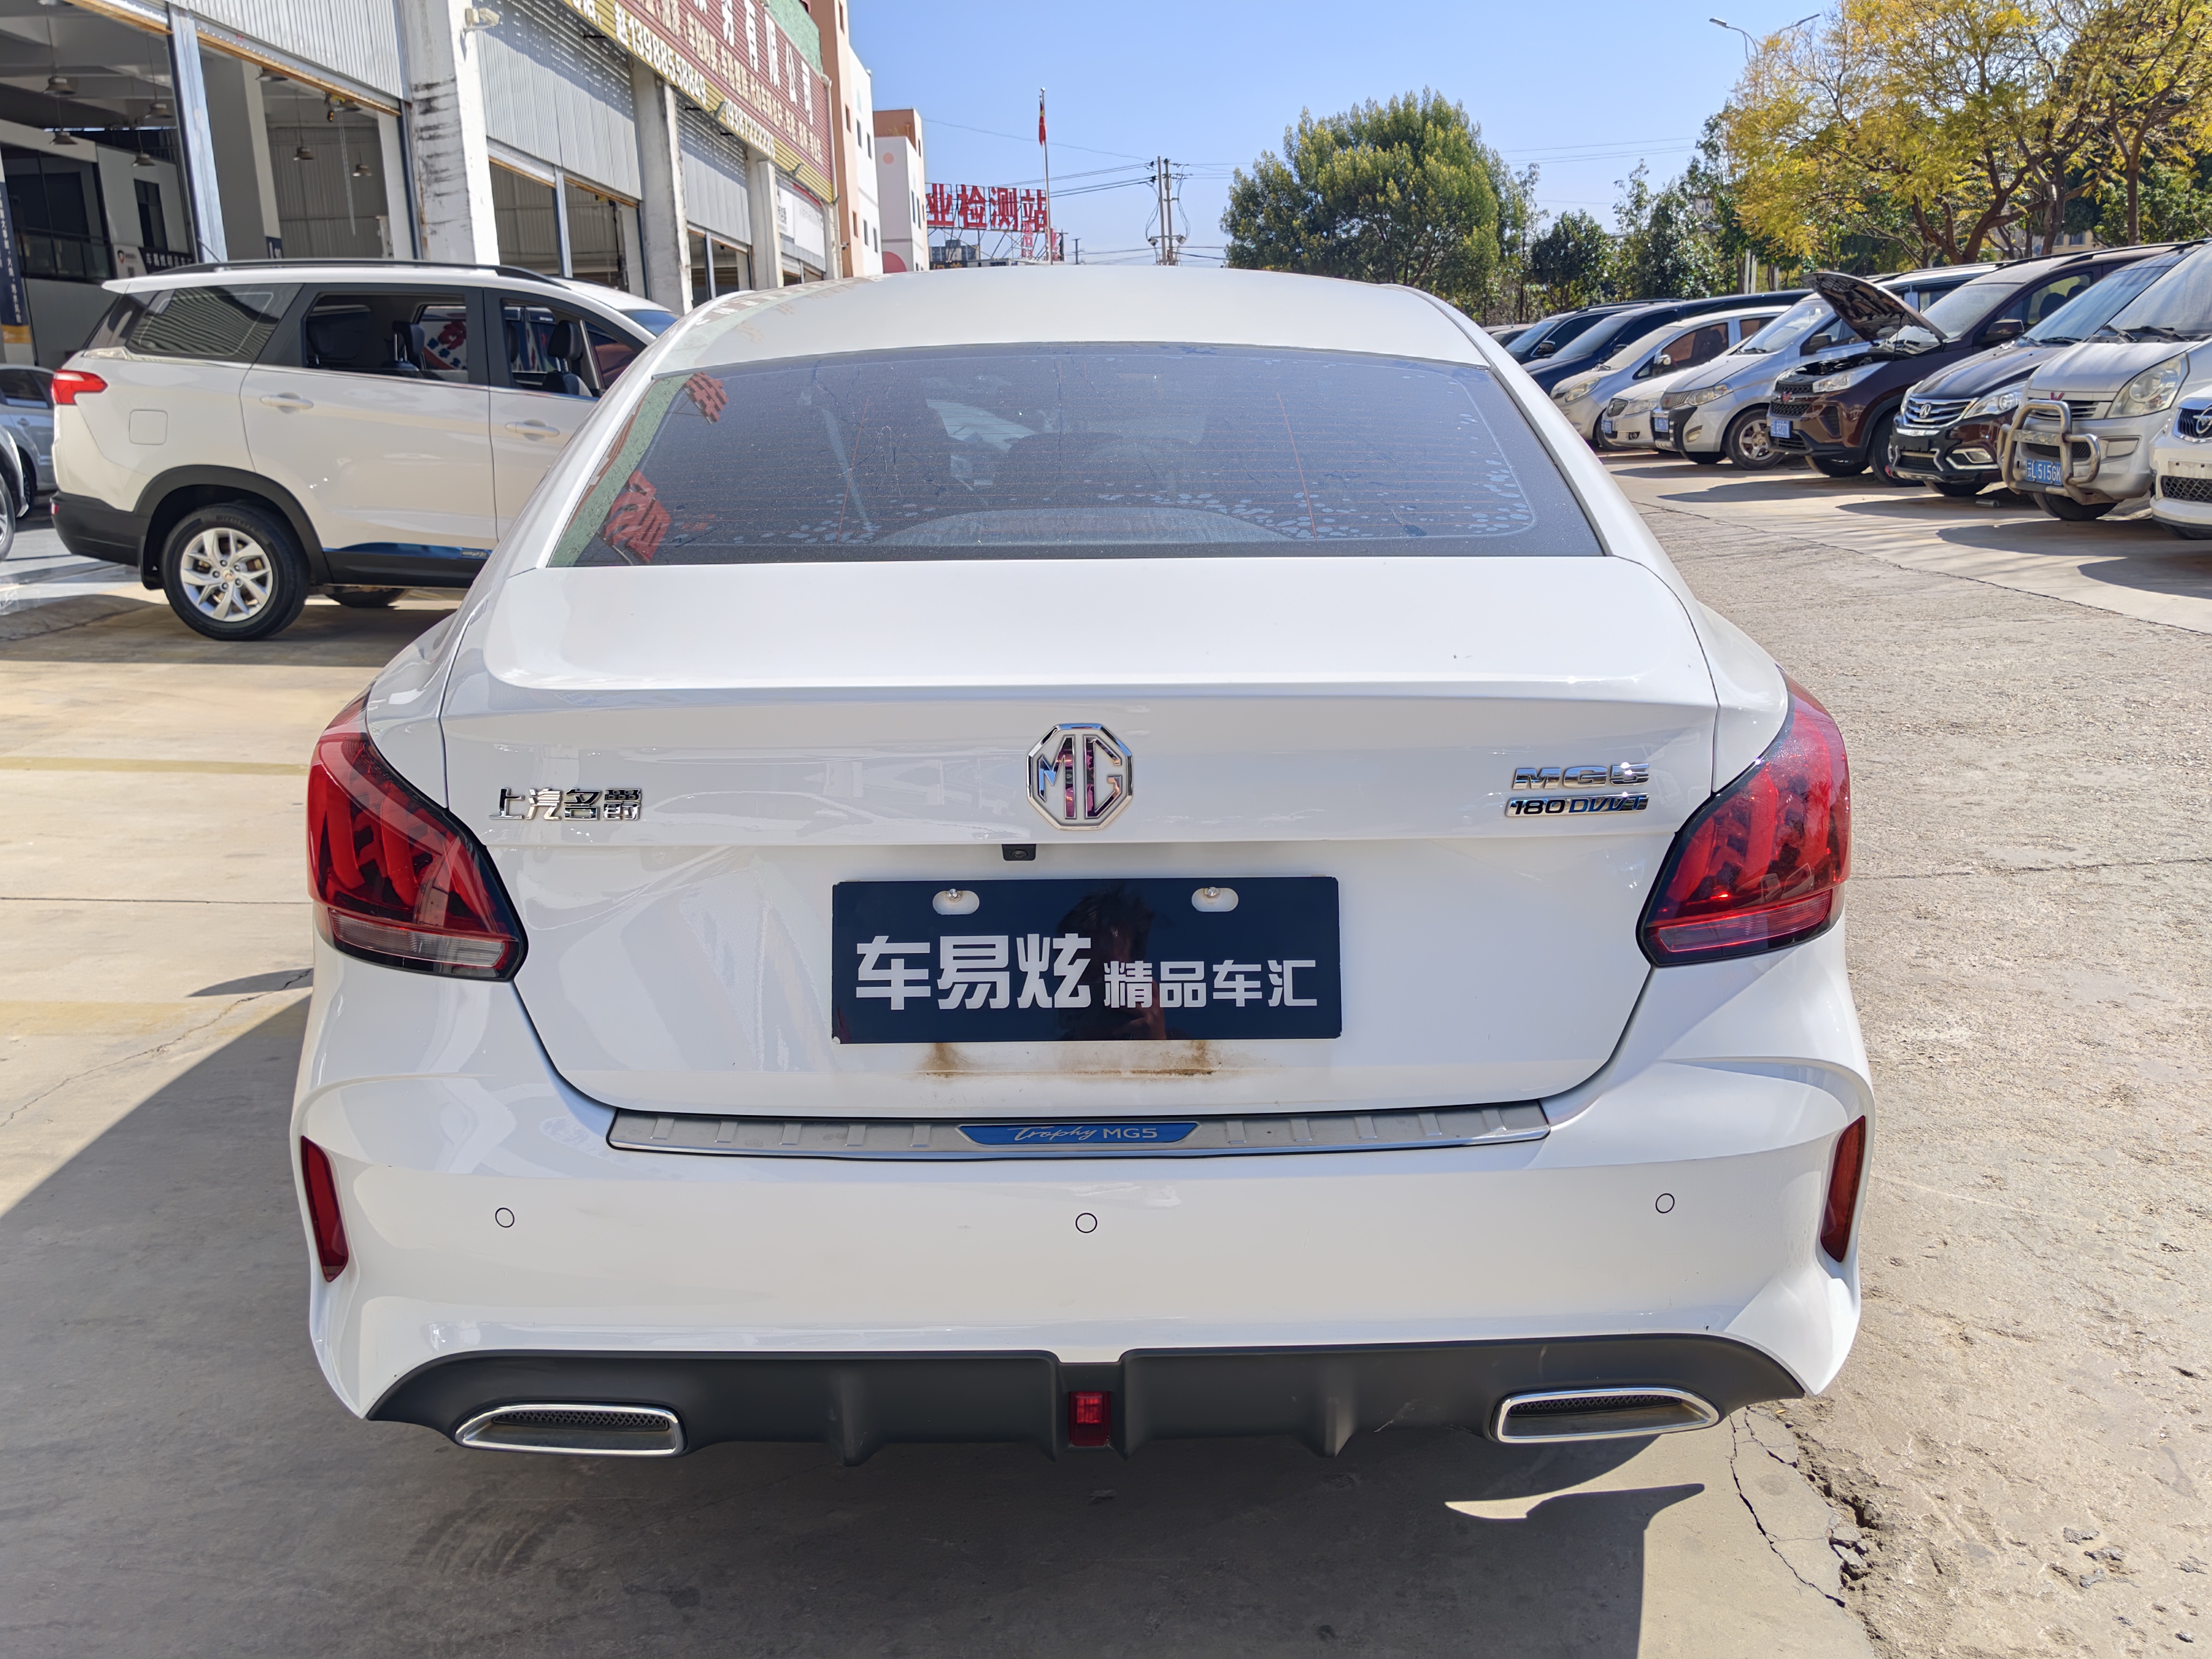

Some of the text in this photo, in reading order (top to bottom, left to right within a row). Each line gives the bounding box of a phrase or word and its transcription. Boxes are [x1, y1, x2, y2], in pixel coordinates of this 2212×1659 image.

[1037, 734, 1123, 820] MG
[1512, 763, 1650, 790] MG5
[489, 787, 643, 821] 上汽名爵
[1007, 1125, 1158, 1141] Trophy MG5
